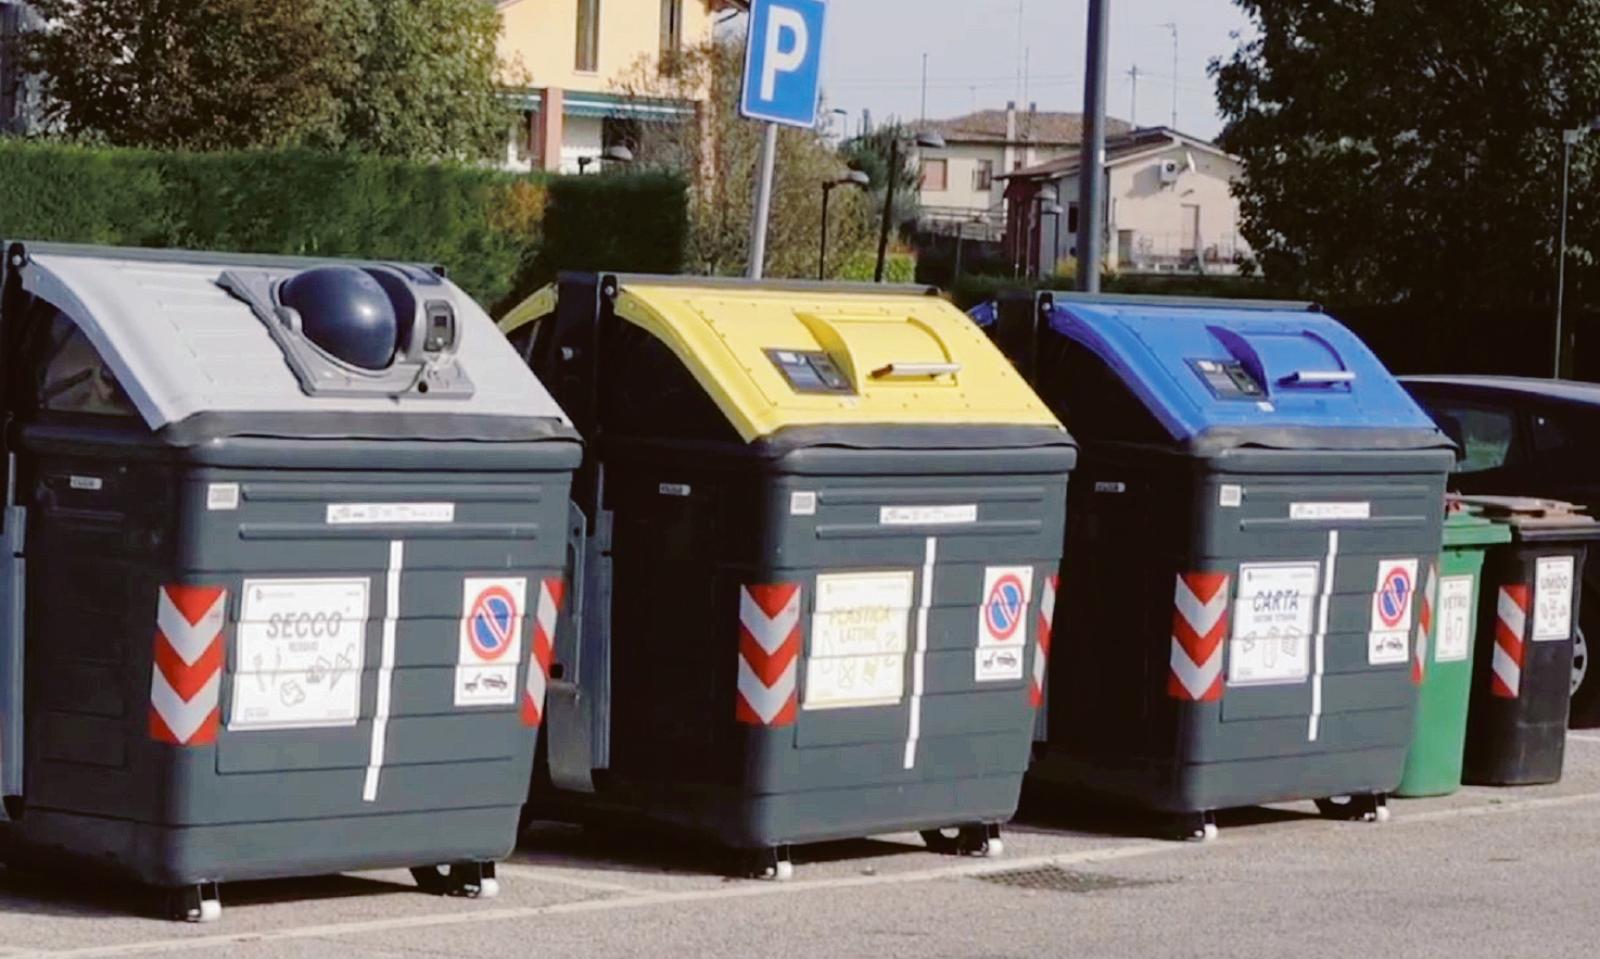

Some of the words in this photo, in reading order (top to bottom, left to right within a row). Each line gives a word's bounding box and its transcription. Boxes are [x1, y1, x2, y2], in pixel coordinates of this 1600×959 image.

[761, 5, 808, 101] P
[1253, 589, 1300, 611] CARTA
[266, 611, 343, 639] SECCO
